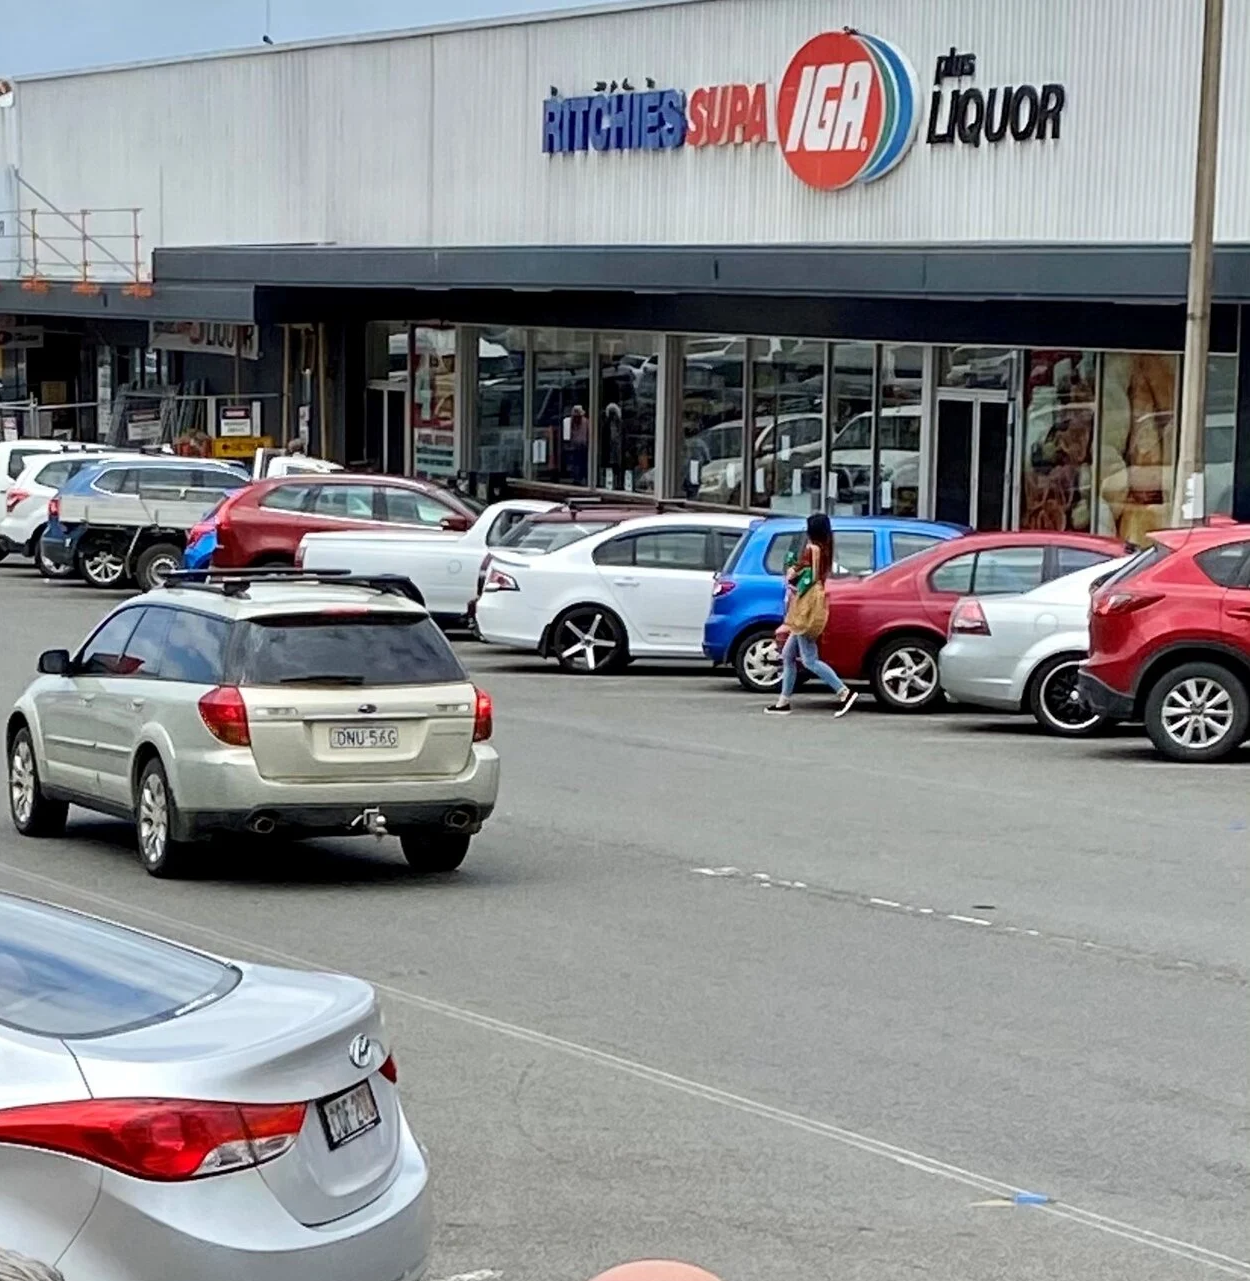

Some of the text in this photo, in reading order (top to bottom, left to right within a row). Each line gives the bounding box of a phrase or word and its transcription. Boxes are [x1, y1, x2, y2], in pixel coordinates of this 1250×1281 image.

[934, 47, 976, 86] plus
[542, 61, 869, 153] RITCHIES SUPA IGA
[926, 84, 1065, 147] LIQUOR
